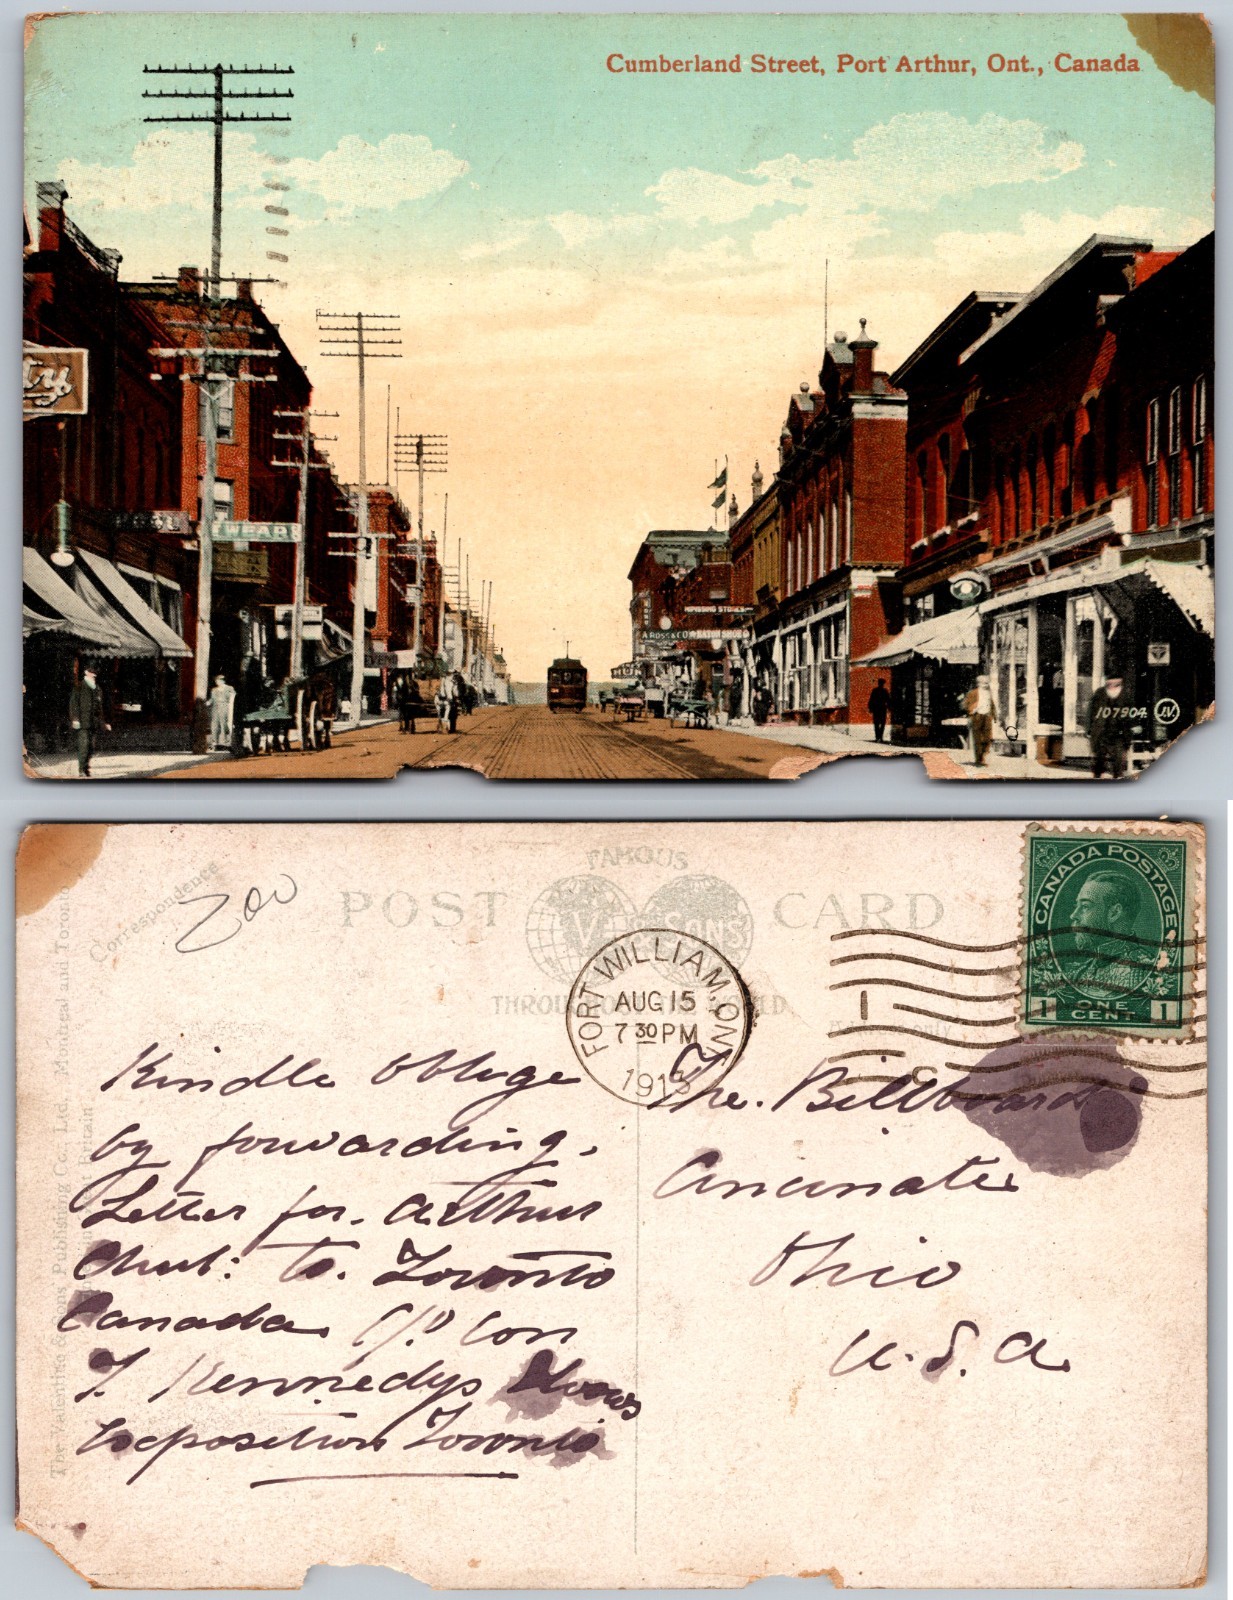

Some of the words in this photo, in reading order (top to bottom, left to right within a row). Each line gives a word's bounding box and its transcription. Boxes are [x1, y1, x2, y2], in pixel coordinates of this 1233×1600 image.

[605, 53, 742, 73] Cumberland
[750, 53, 826, 76] Street,
[836, 53, 887, 73] Port
[895, 54, 977, 76] Arthur,
[987, 53, 1044, 76] Ont.,
[1054, 52, 1141, 73] Canada
[585, 847, 689, 871] FAMOUS
[1035, 844, 1103, 925] CANADA
[1107, 844, 1178, 928] POSTAGE
[54, 885, 71, 955] Toronto
[89, 861, 220, 964] Correspondence
[338, 890, 508, 929] POST
[773, 892, 945, 930] CARD
[55, 960, 70, 992] and
[615, 990, 663, 1012] AUG
[671, 990, 697, 1012] 15
[1037, 1000, 1048, 1018] 1
[1070, 1010, 1137, 1022] CENT
[1076, 1000, 1129, 1011] ONE
[1159, 1002, 1168, 1021] 1
[54, 997, 70, 1077] Montreal
[576, 981, 610, 1058] FORT
[69, 1122, 171, 1213] by
[749, 1230, 962, 1289] Ohio
